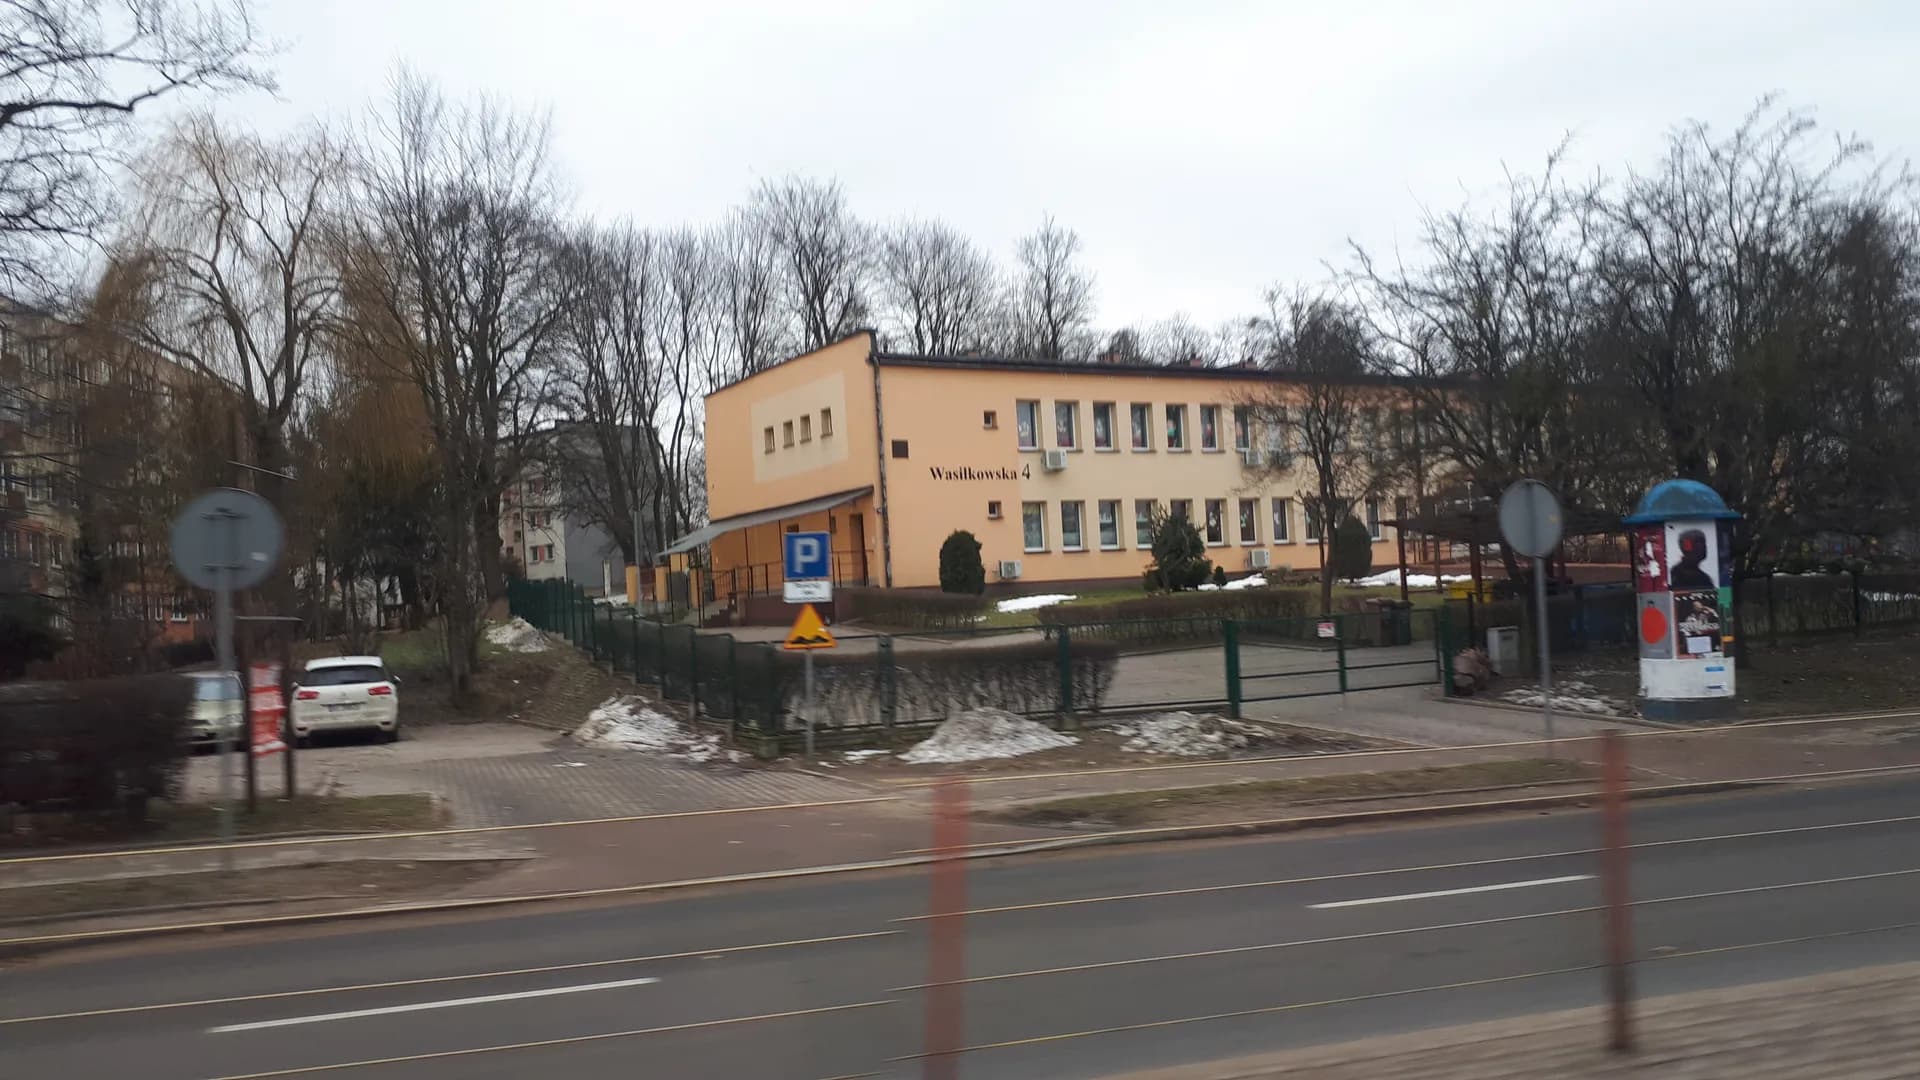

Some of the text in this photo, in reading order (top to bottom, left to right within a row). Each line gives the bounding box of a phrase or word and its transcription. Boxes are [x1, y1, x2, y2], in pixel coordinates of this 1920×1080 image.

[930, 463, 1031, 481] Wasilkowska 4
[793, 537, 820, 574] P
